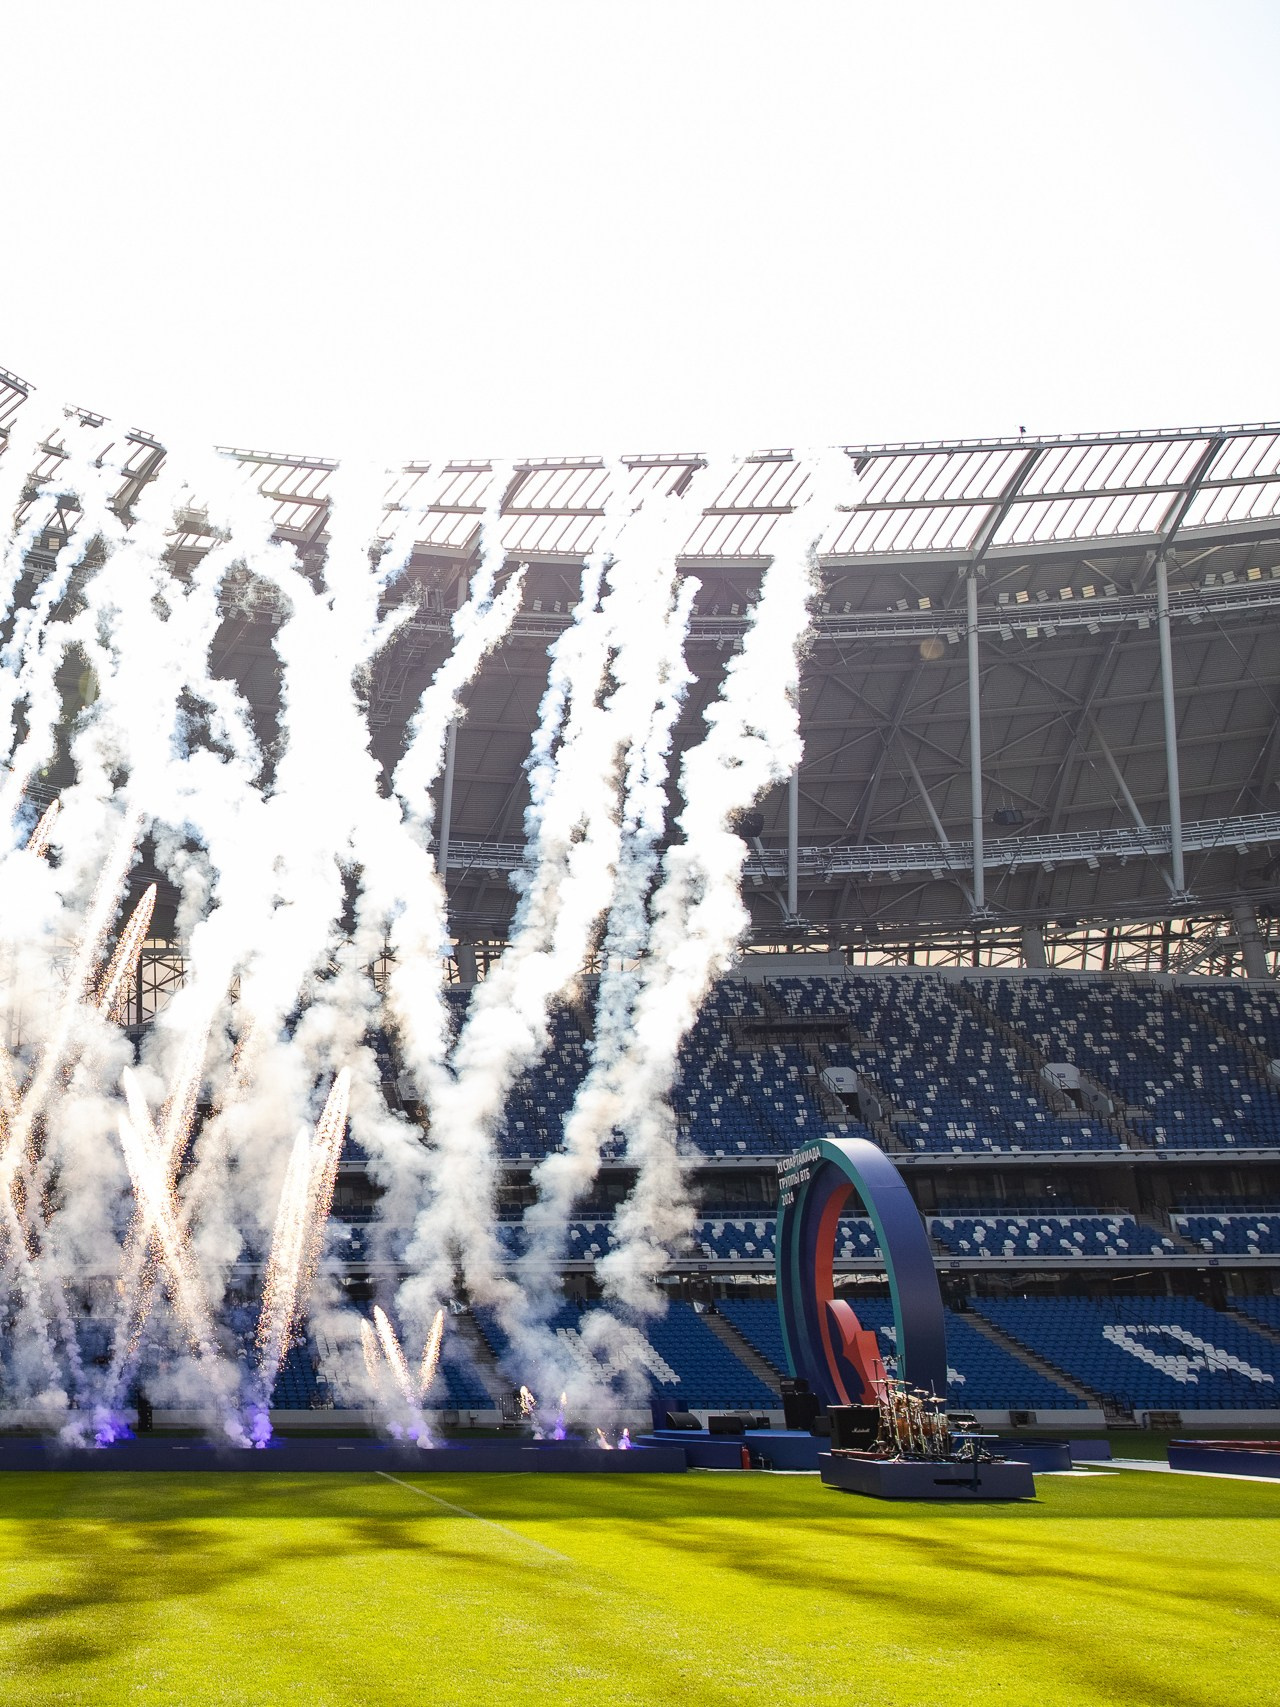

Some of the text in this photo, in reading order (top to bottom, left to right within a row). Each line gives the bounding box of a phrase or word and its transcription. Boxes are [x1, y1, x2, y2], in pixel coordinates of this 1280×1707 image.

[776, 1146, 821, 1174] XI СПАРТАКИАДА
[778, 1167, 810, 1190] ГРУППЫ ВТБ
[781, 1191, 795, 1206] 2024
